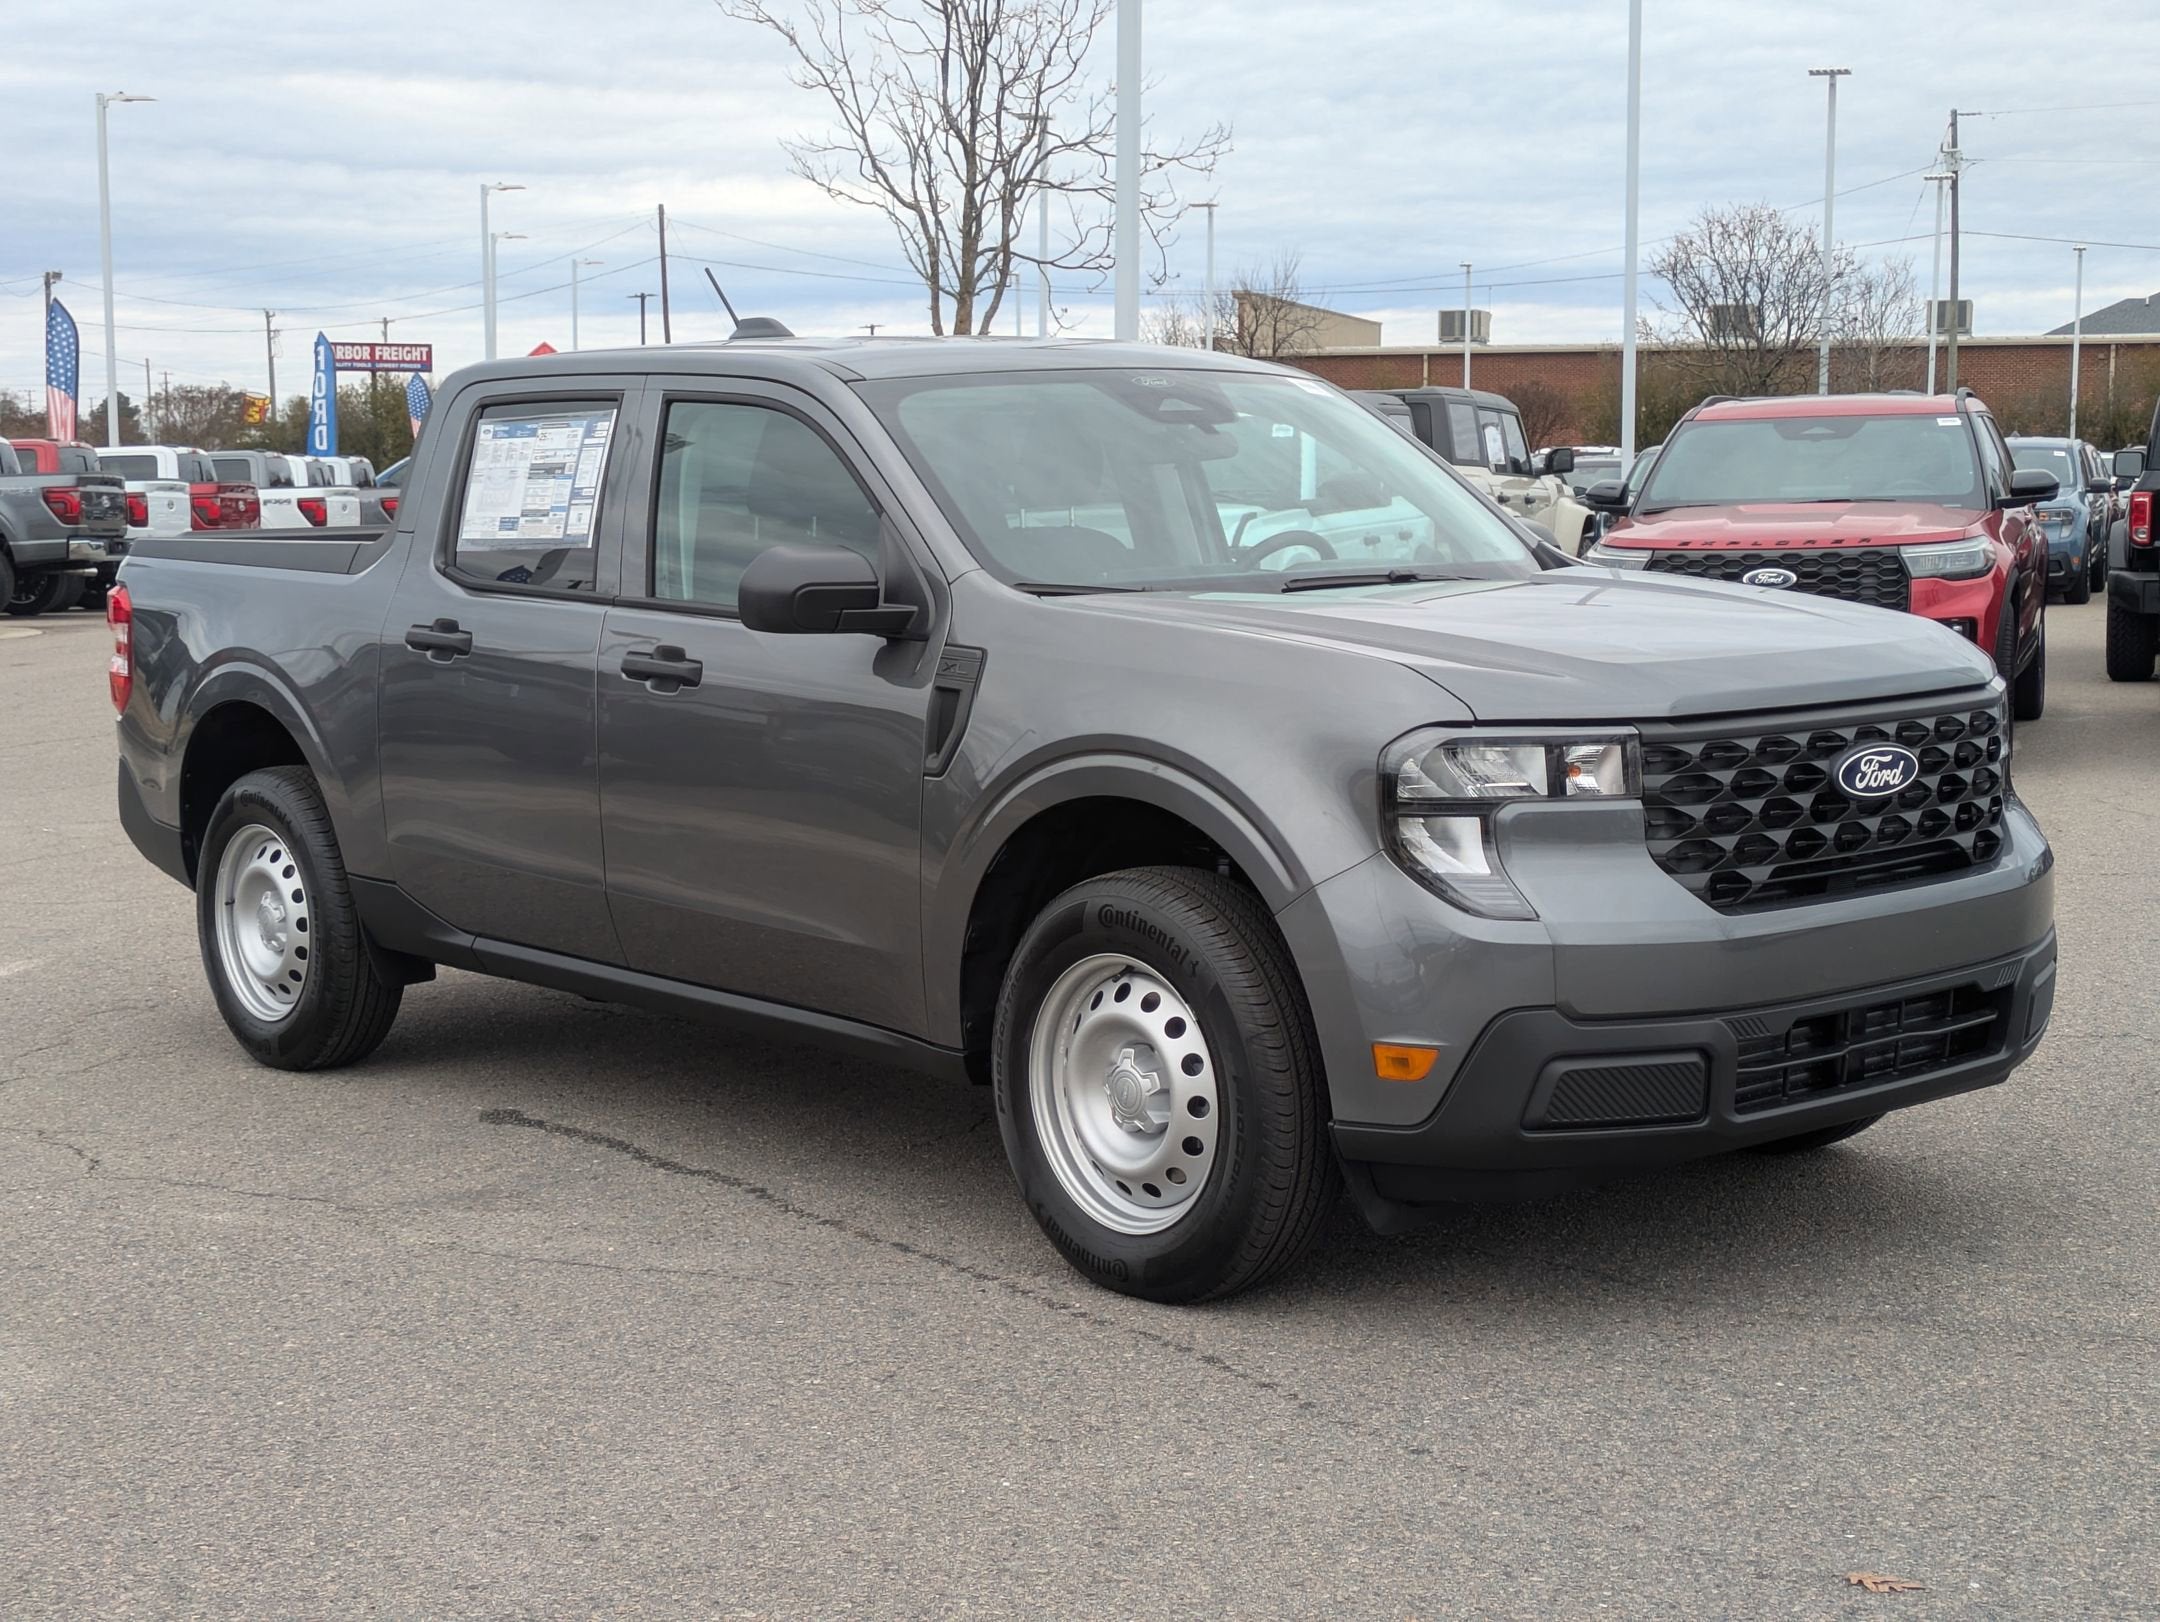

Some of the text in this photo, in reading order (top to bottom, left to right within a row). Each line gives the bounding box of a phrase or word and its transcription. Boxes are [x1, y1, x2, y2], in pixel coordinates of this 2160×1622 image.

[375, 346, 429, 361] FREIGHT
[1677, 537, 1872, 547] EXPLORER
[1754, 573, 1785, 585] Ford
[942, 662, 969, 676] XL
[1855, 754, 1905, 789] Ford
[1097, 903, 1191, 966] Continental
[1043, 1214, 1129, 1283] Continental
